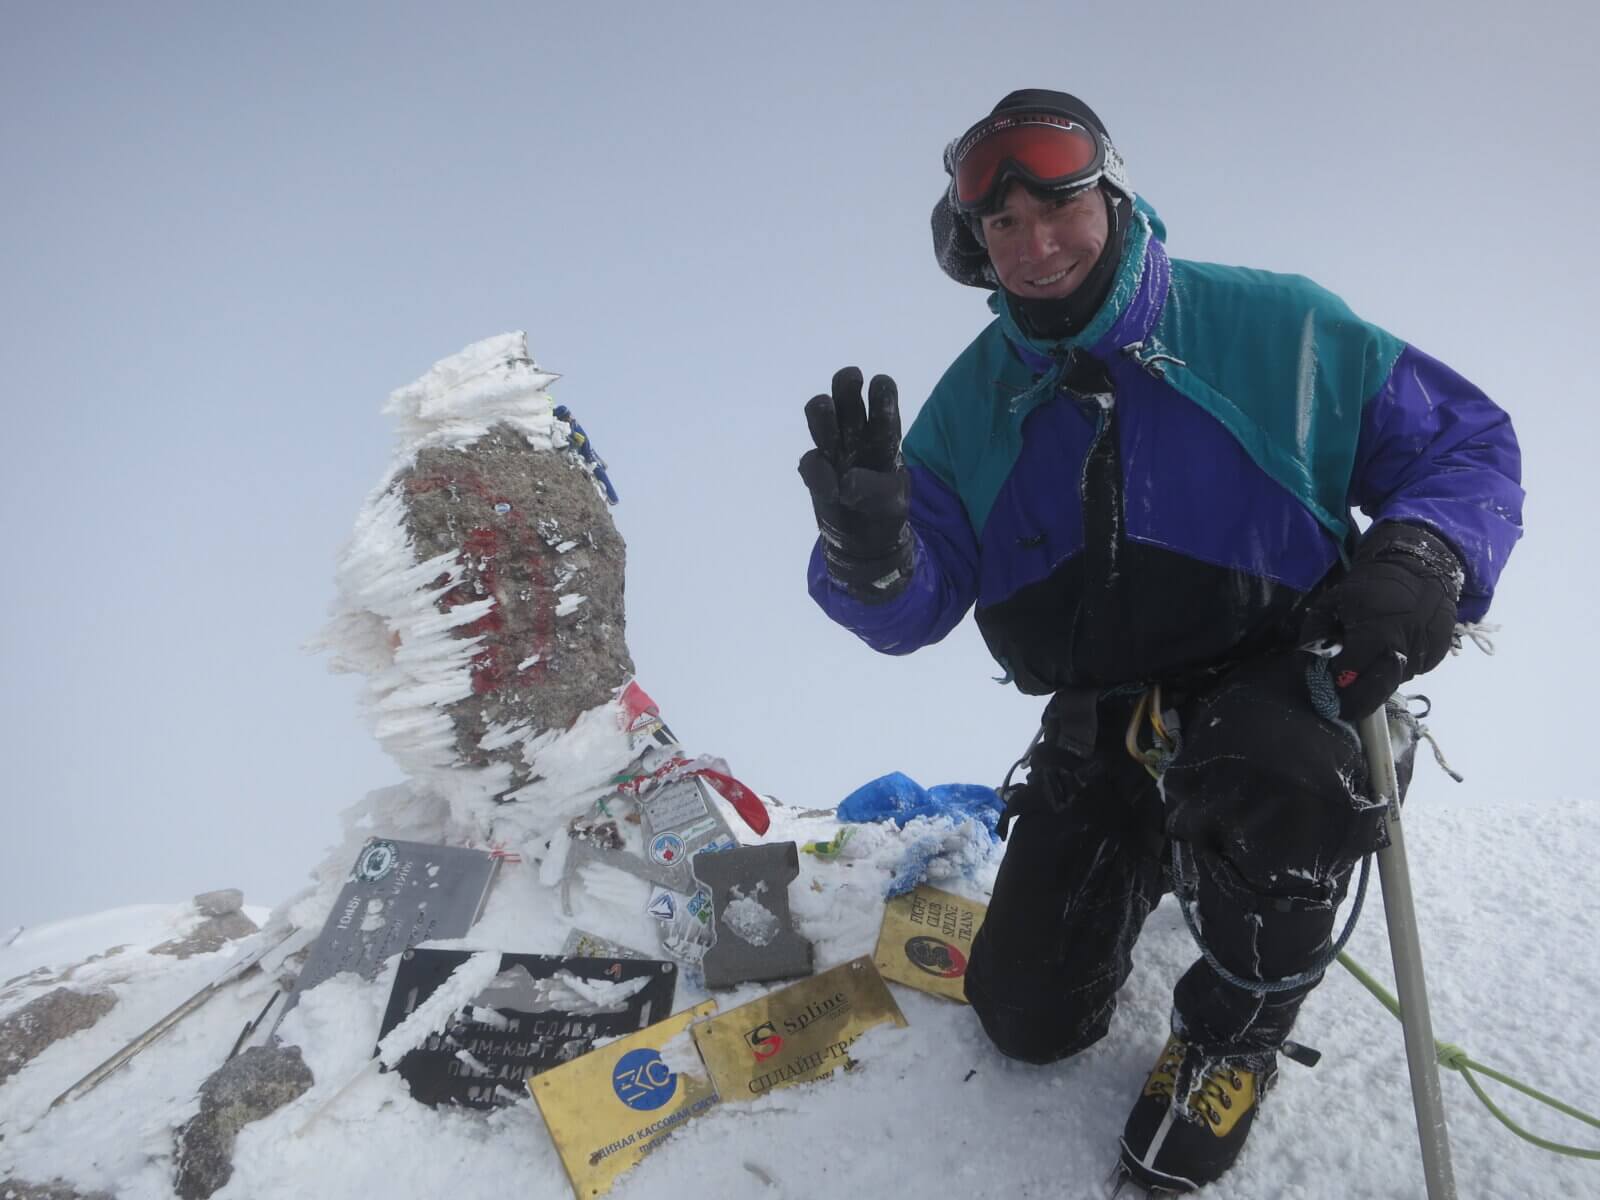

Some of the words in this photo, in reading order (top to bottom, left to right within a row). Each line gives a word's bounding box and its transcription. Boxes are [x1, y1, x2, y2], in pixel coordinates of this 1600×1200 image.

[910, 895, 927, 925] FIGHT
[927, 903, 943, 928] CLUB
[942, 904, 958, 937] SPLINE
[958, 910, 974, 942] TRANS
[783, 991, 847, 1034] Spline
[748, 1032, 863, 1094] СПЛАЙН-ТР
[637, 1108, 691, 1140] КАССОВАЯ
